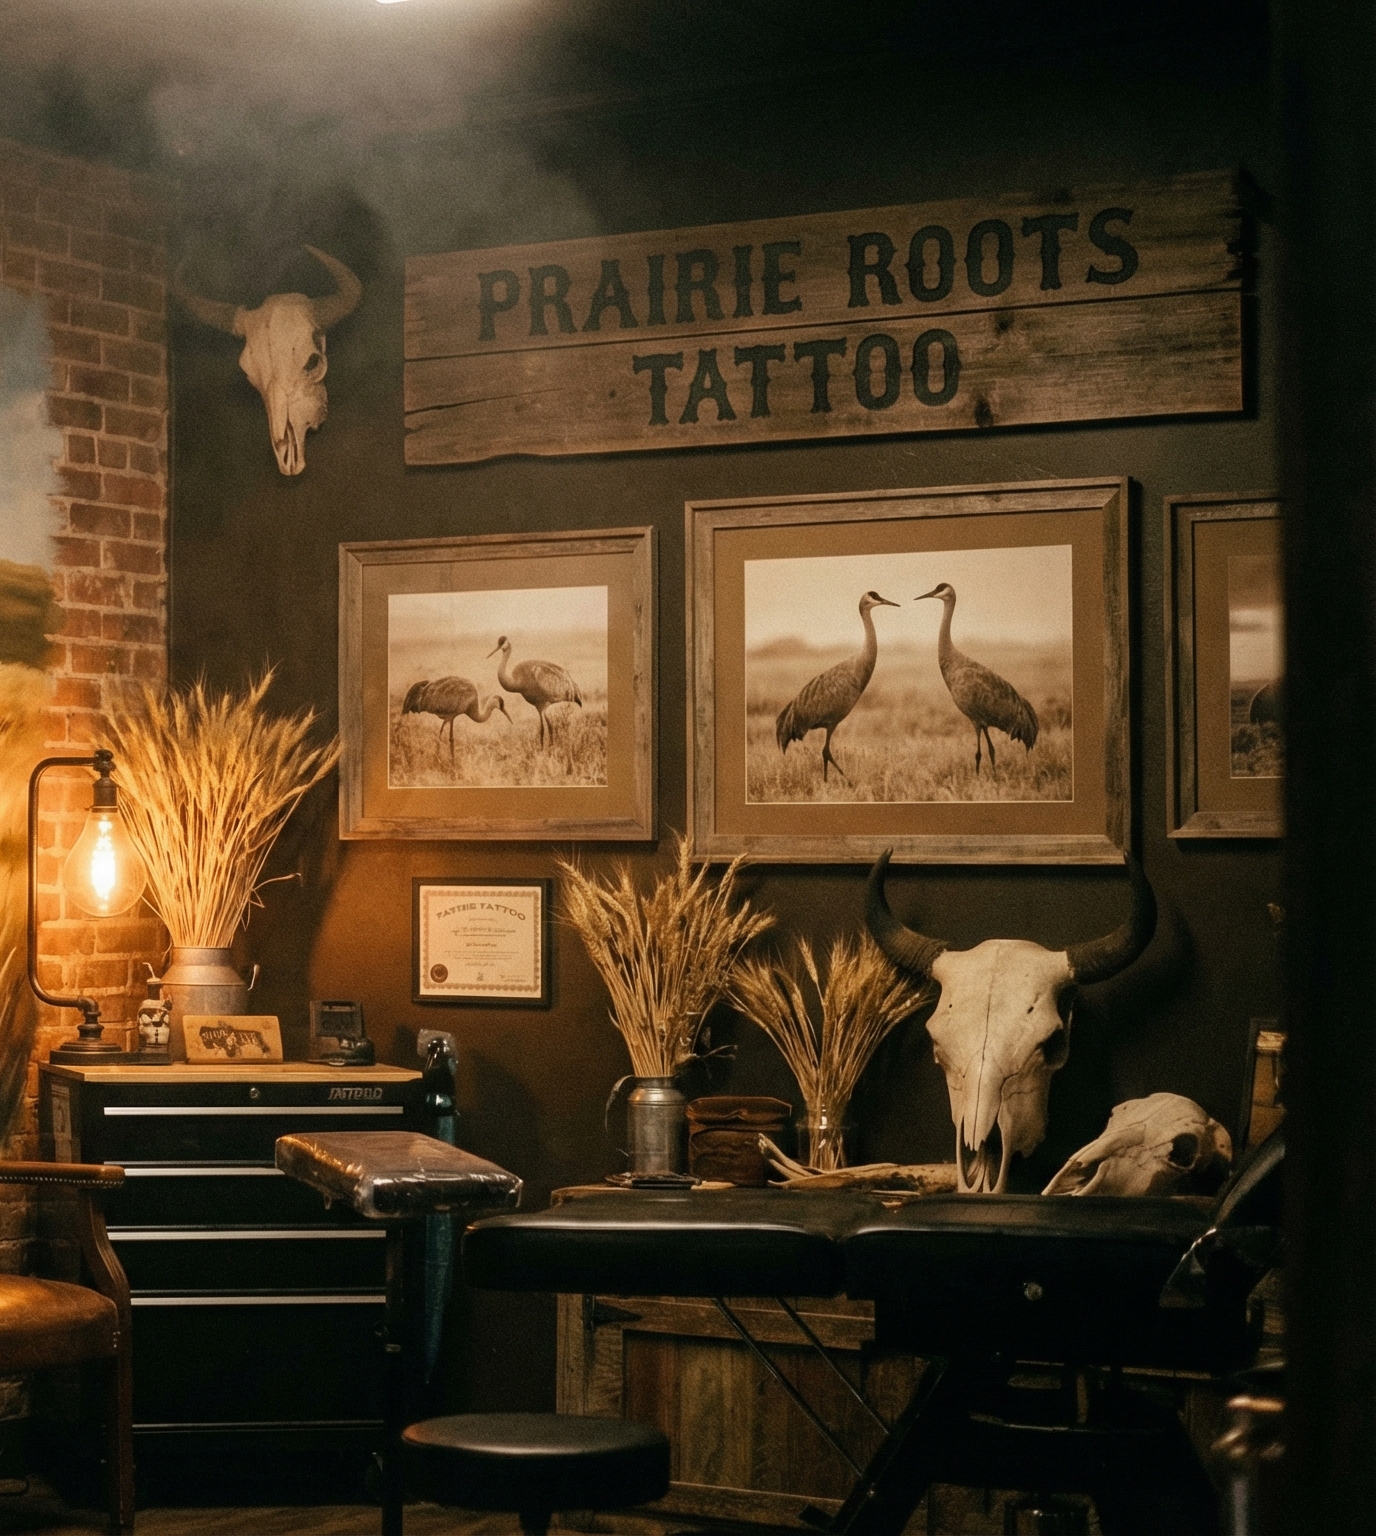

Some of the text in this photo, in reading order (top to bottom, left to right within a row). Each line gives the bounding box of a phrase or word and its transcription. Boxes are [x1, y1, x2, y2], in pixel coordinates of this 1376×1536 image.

[477, 206, 1140, 342] PRAIRIE ROOTS
[632, 328, 963, 426] TATTOO
[480, 903, 525, 920] TATTOO
